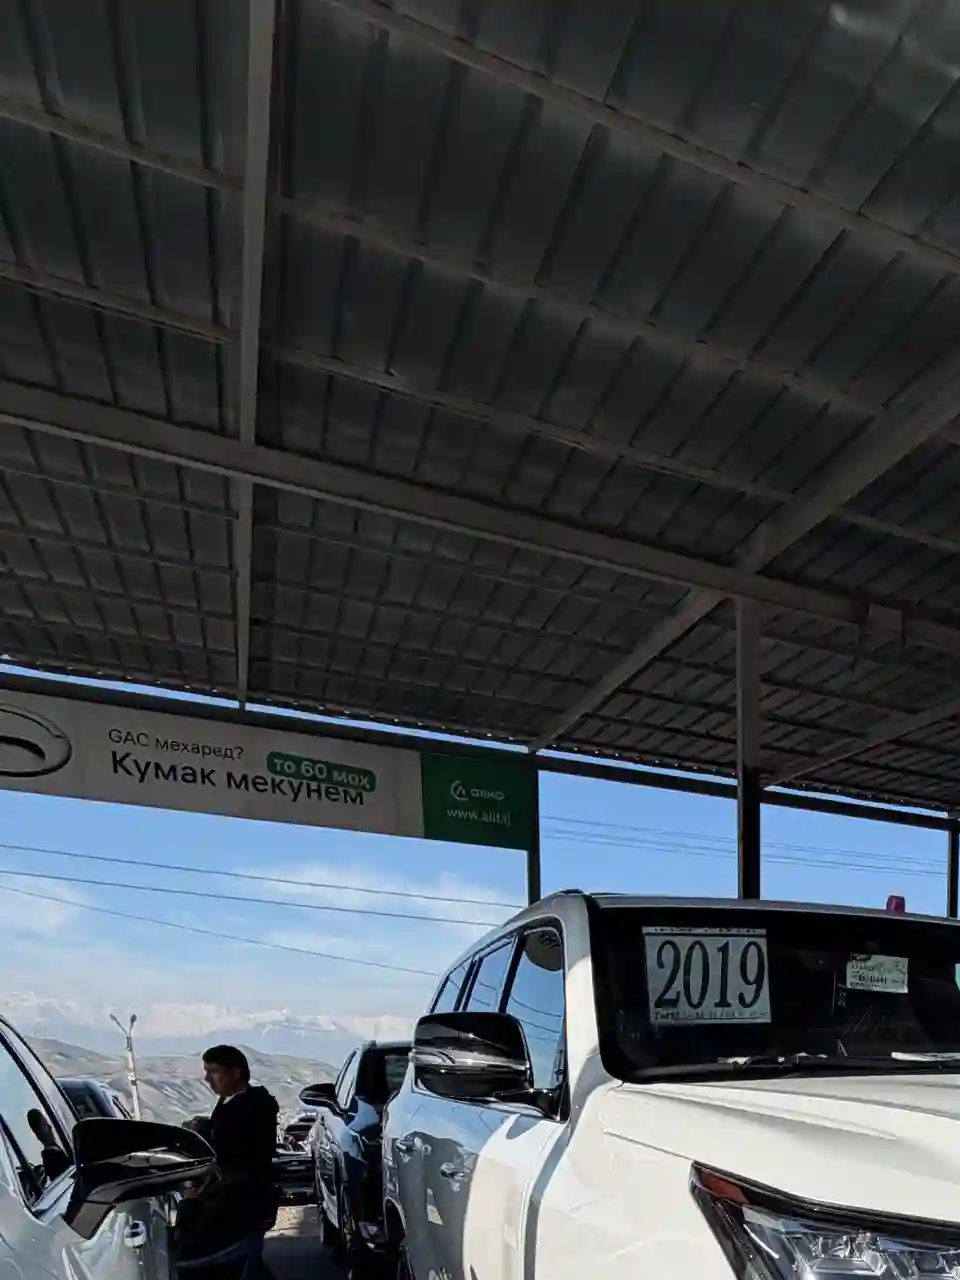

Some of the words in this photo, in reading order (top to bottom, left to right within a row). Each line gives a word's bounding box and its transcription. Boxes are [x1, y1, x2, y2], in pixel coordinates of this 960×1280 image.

[155, 737, 244, 760] мехаред?
[110, 750, 217, 787] Кумак
[226, 771, 364, 805] мекунем
[273, 759, 297, 772] то
[300, 761, 328, 779] 60
[653, 939, 766, 1010] 2019
